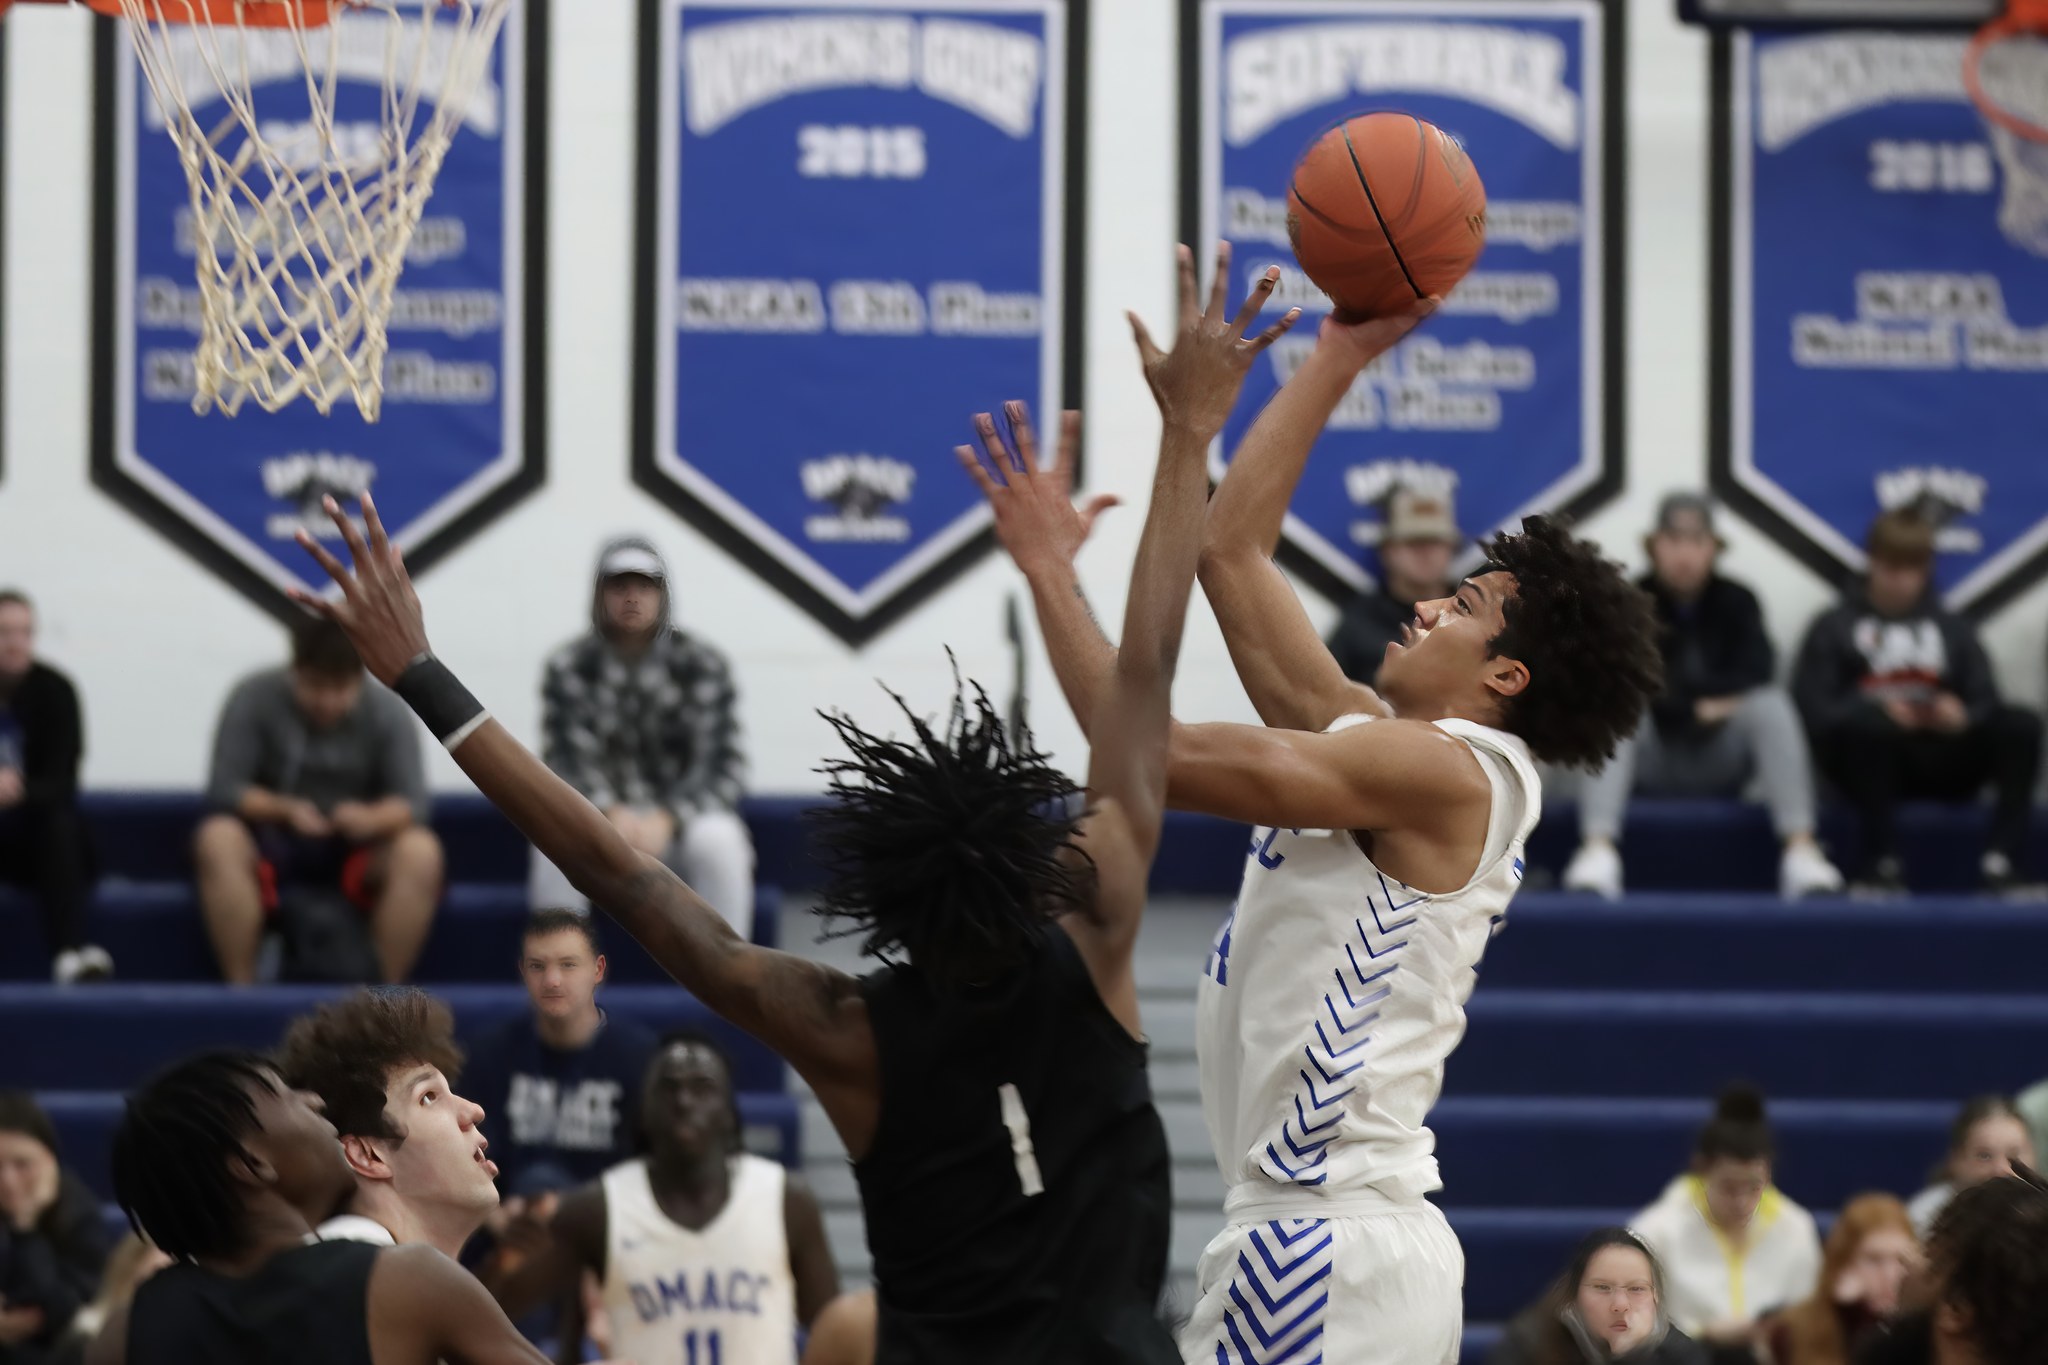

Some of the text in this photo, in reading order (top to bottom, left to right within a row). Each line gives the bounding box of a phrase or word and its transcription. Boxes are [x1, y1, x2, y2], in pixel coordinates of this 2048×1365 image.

[1225, 22, 1579, 149] SOFTBALL
[798, 125, 926, 178] 2015
[997, 1082, 1046, 1198] 1
[629, 1269, 772, 1324] DMACC
